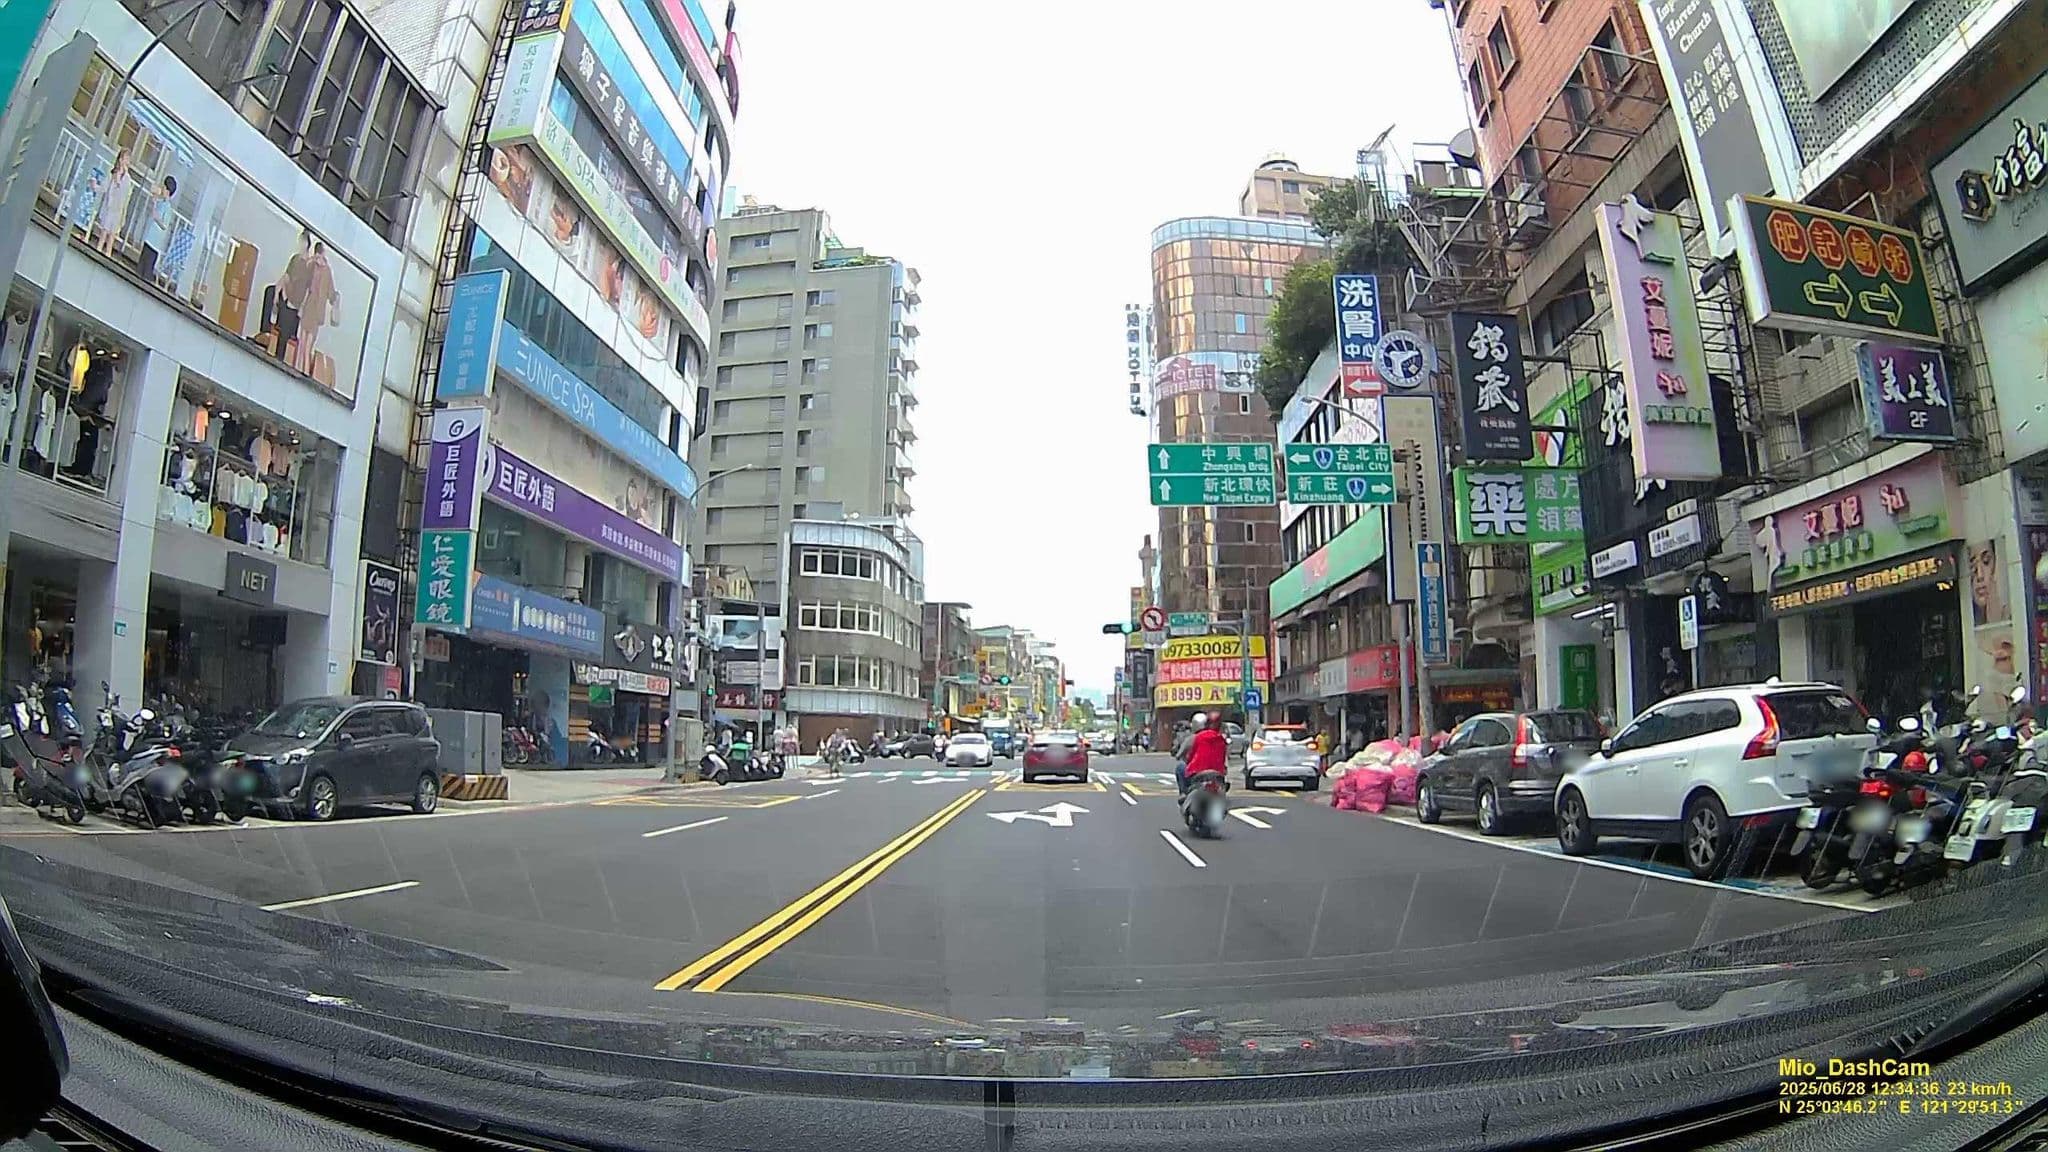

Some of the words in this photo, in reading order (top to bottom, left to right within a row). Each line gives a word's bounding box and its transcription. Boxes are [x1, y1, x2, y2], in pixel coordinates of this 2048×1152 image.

[1679, 11, 1712, 53] Church
[1339, 279, 1376, 338] 洗腎
[1344, 343, 1376, 359] 中心
[515, 336, 570, 406] EUNICE
[572, 382, 595, 426] SPA
[1909, 411, 1928, 428] 2F
[1201, 446, 1269, 461] 中興橋
[1336, 446, 1388, 461] 台北市
[1336, 462, 1364, 472] Taipei
[1368, 462, 1389, 473] City
[439, 444, 463, 518] 巨匠外語
[499, 460, 555, 513] 巨匠外語
[1204, 477, 1271, 493] 新北環快
[1297, 476, 1337, 492] 新莊
[1203, 493, 1219, 503] New
[1222, 493, 1243, 504] Taipei
[1294, 493, 1344, 504] Xinzhuang
[1466, 473, 1527, 535] 藥
[240, 570, 268, 592] NET
[369, 571, 396, 593] Curves
[424, 535, 456, 624] 仁愛眼鏡
[1171, 686, 1202, 701] 8899
